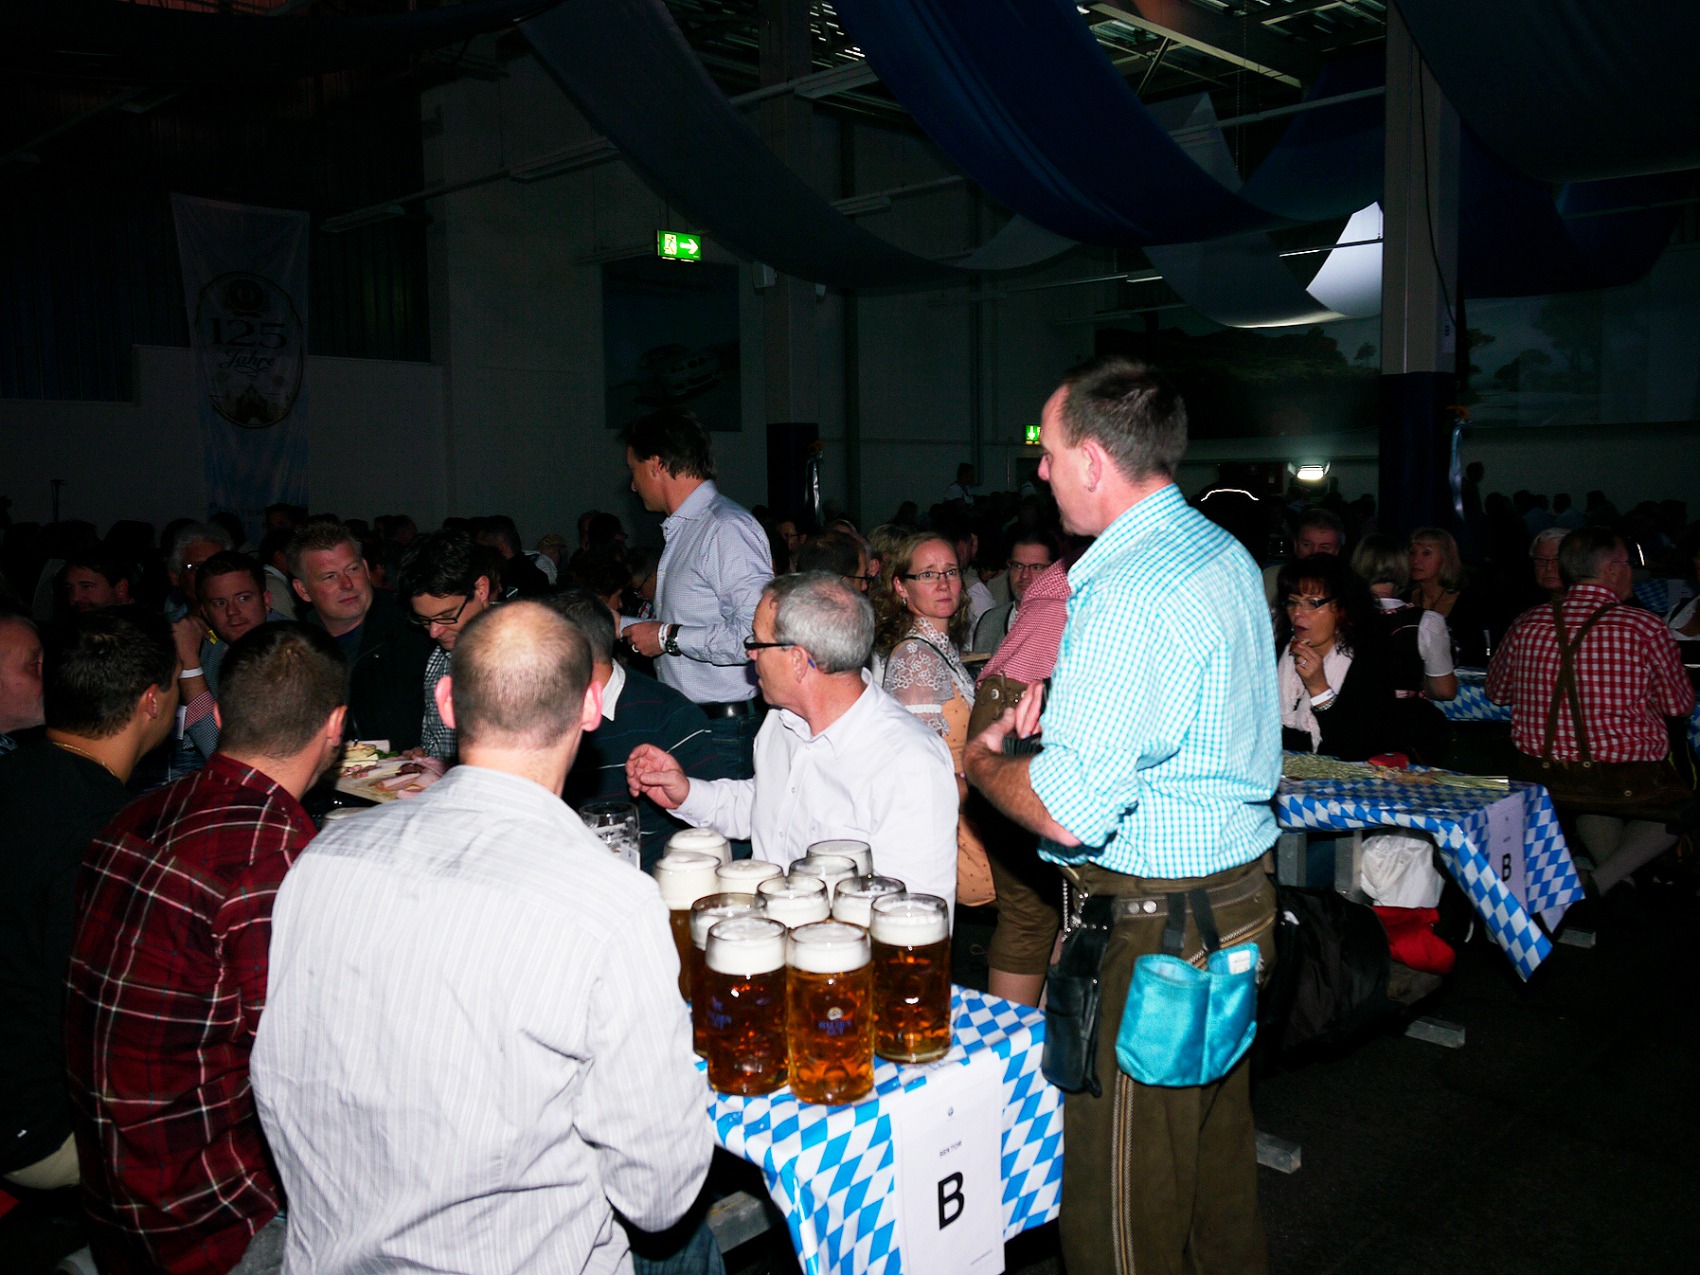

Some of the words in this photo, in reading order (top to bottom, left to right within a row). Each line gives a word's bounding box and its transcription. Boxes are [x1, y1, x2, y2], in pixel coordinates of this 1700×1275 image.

[210, 318, 287, 349] 125
[219, 348, 275, 372] Jahre
[1502, 853, 1511, 881] B
[937, 1172, 965, 1230] B
